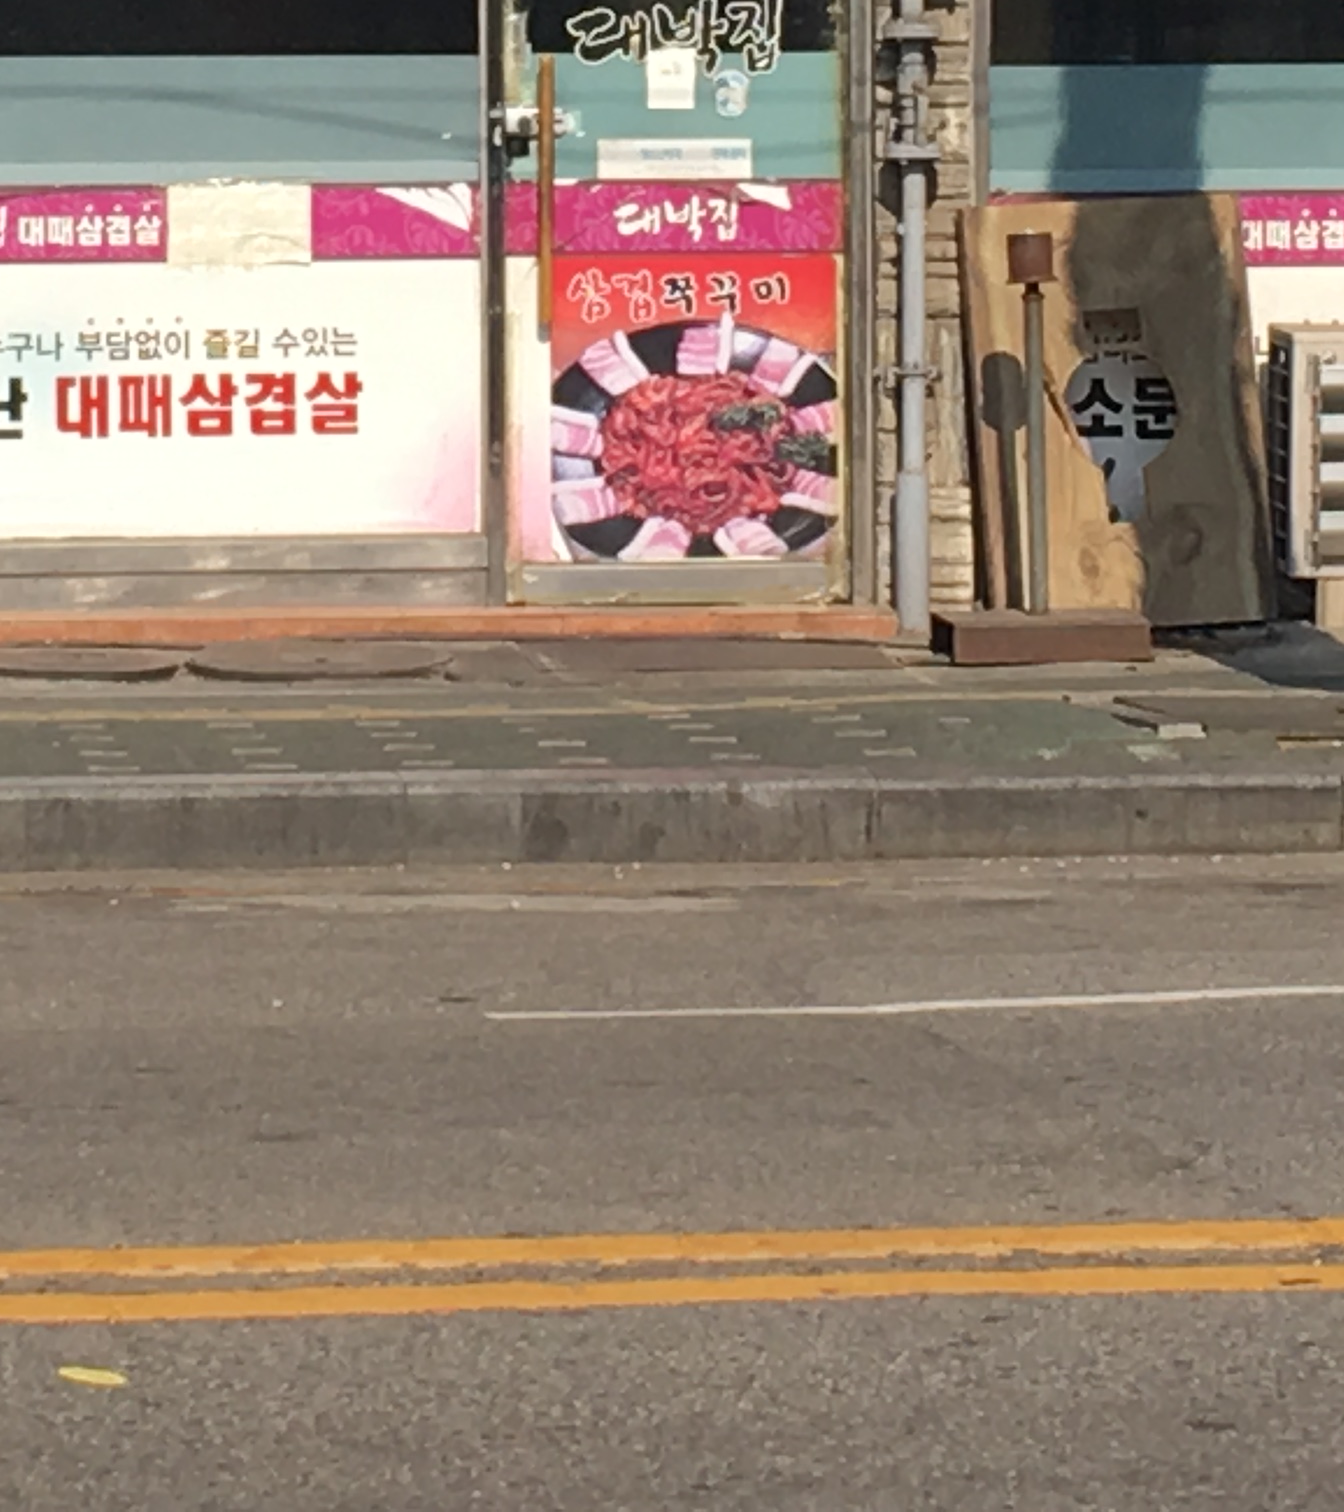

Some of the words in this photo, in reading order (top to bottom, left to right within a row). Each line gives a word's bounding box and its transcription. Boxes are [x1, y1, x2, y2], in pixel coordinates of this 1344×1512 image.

[17, 214, 162, 247] 대패삼겹살
[613, 194, 738, 242] 대박집
[75, 330, 191, 361] 부담없이
[203, 328, 261, 360] 즐길
[271, 328, 359, 358] 수있는
[56, 372, 364, 439] 대패삼겹살
